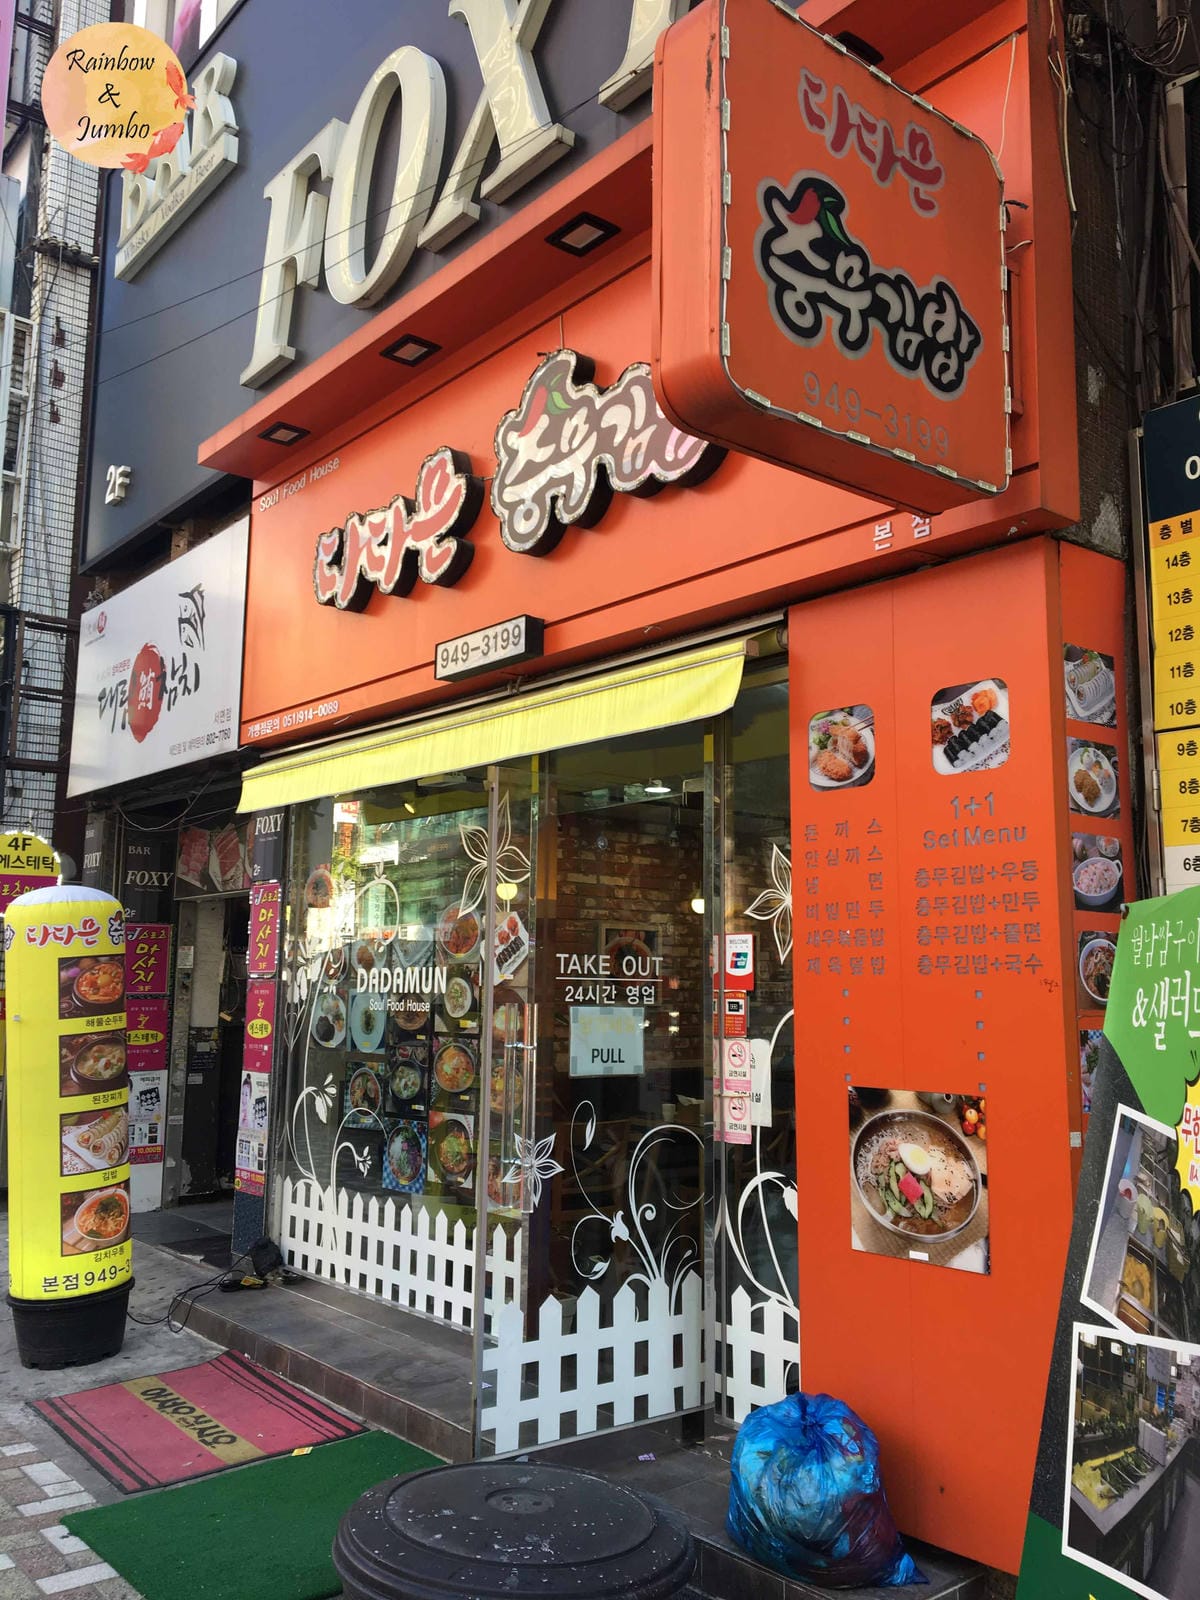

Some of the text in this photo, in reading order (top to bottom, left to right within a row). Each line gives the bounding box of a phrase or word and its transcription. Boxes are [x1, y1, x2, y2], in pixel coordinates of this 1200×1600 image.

[761, 176, 982, 394] 충무김밥
[803, 370, 949, 459] 949-3199
[105, 464, 131, 505] 2F
[259, 457, 340, 512] Soul Food House
[1166, 551, 1191, 569] 14층
[1167, 588, 1193, 606] 13층
[1168, 625, 1195, 642] 12층
[440, 624, 521, 669] 949-3199
[1169, 662, 1195, 679] 11층
[1169, 699, 1197, 716] 10층
[1177, 740, 1198, 757] 9층
[1179, 778, 1200, 794] 8층
[950, 792, 995, 820] 1+1
[255, 814, 284, 836] FOXY
[8, 837, 32, 851] 4F
[128, 845, 151, 855] BAR
[0, 855, 55, 872] 에스테틱
[124, 870, 174, 887] FOXY
[914, 860, 1039, 888] 충무김밥+우동
[124, 908, 136, 918] 2F
[915, 891, 1041, 917] 충무김밥+만두
[556, 953, 664, 976] TAKE OUT
[917, 953, 1043, 976] 충무김밥+국수
[356, 966, 447, 994] DADAMUN
[564, 984, 655, 1005] 24시간 영업
[369, 998, 431, 1012] Soul Food House
[591, 1048, 625, 1064] PULL
[102, 1170, 118, 1182] 김밥
[42, 1273, 79, 1293] 본점
